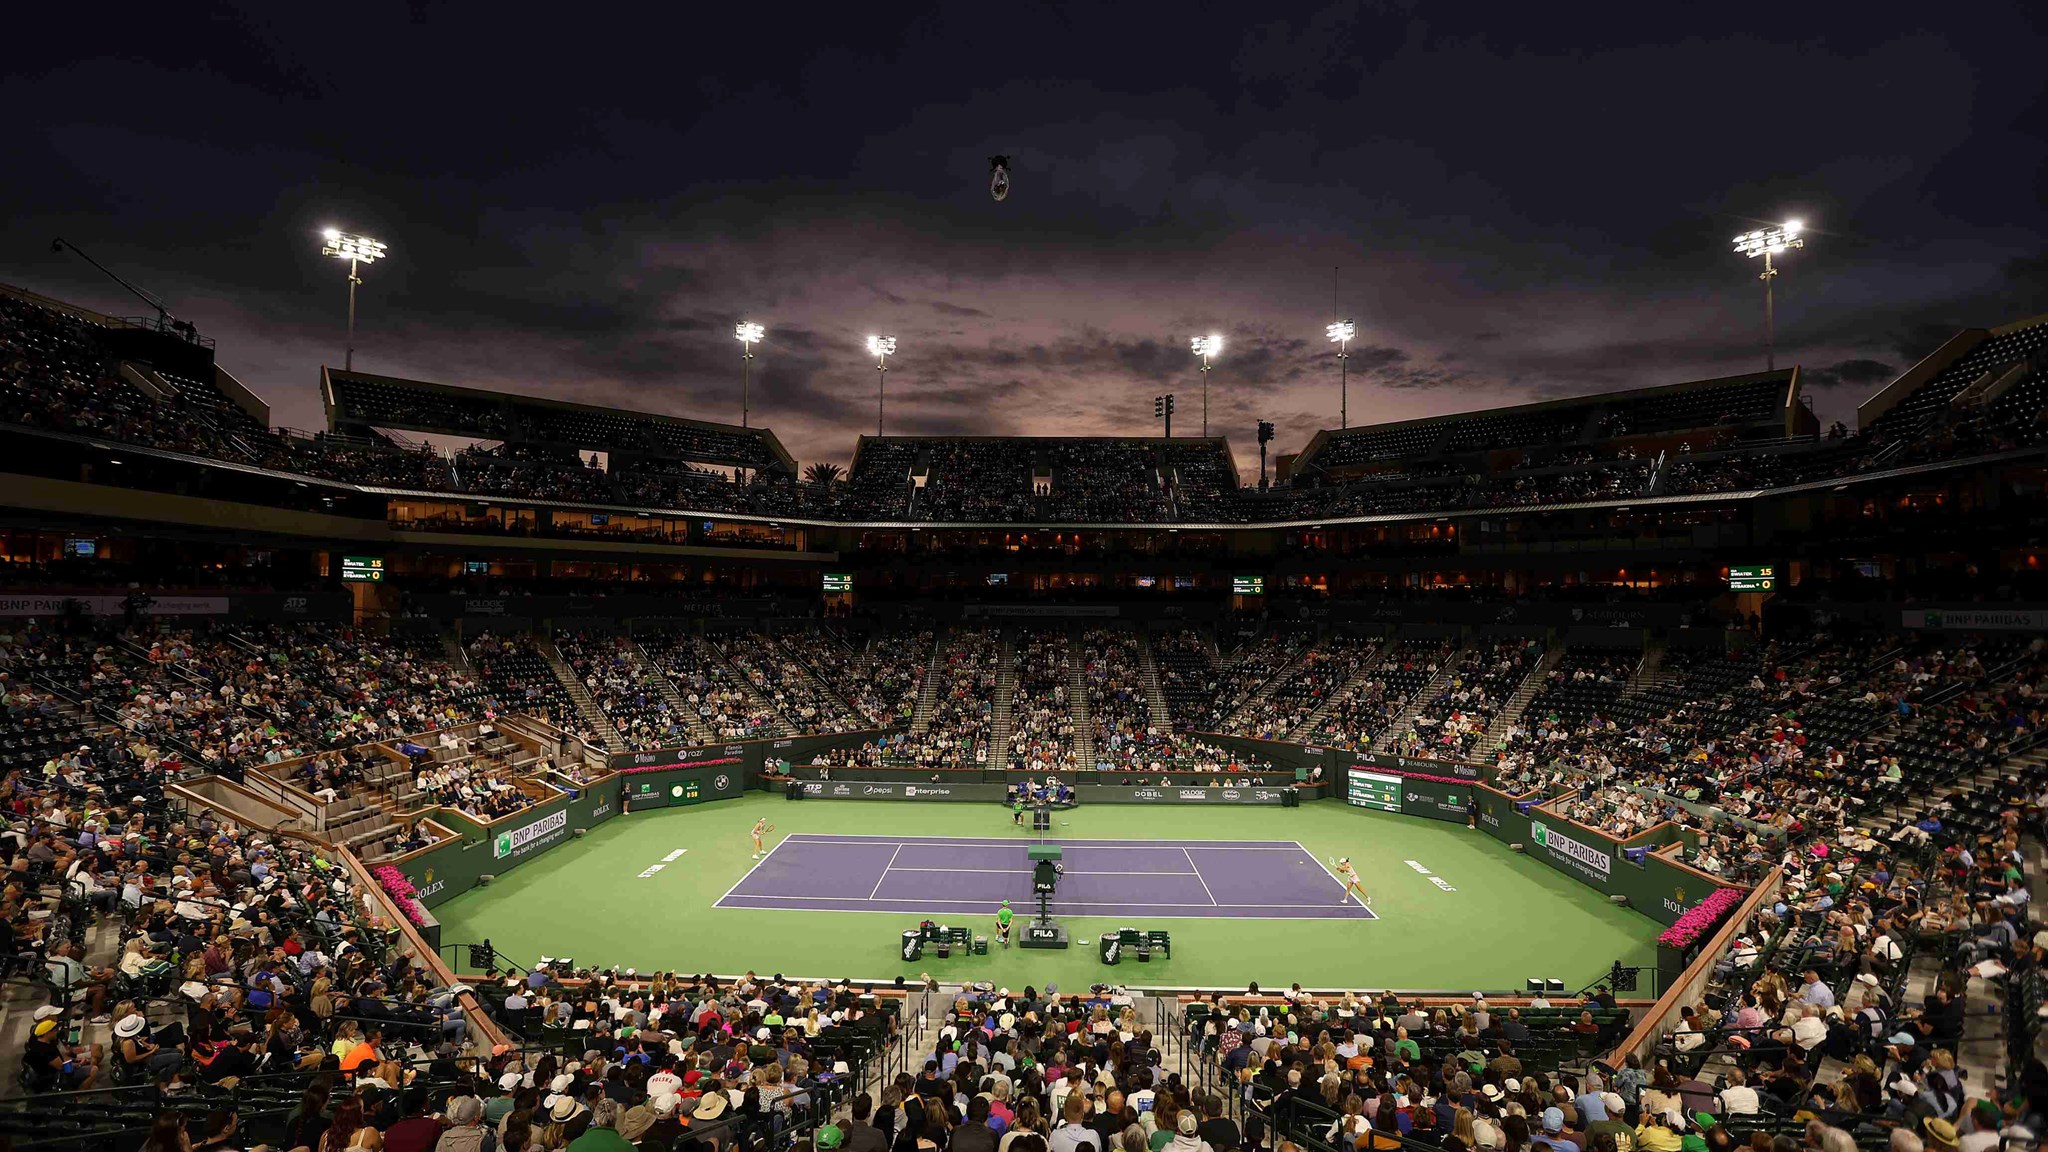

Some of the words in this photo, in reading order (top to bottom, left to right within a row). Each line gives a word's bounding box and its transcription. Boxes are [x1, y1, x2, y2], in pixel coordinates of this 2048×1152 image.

[372, 571, 380, 580] 0
[1762, 580, 1771, 589] 0
[0, 600, 30, 610] BNP
[1946, 615, 1969, 624] BNP
[1975, 615, 2031, 625] PARIBAS
[1356, 753, 1376, 762] FILA
[1407, 760, 1438, 768] SEABOURN
[593, 804, 610, 817] ROLEX
[1482, 813, 1499, 827] ROLEX
[514, 828, 530, 846] BNP
[533, 812, 564, 836] PARIBAS
[1548, 832, 1565, 849] BNP
[1568, 841, 1606, 869] PARIBAS
